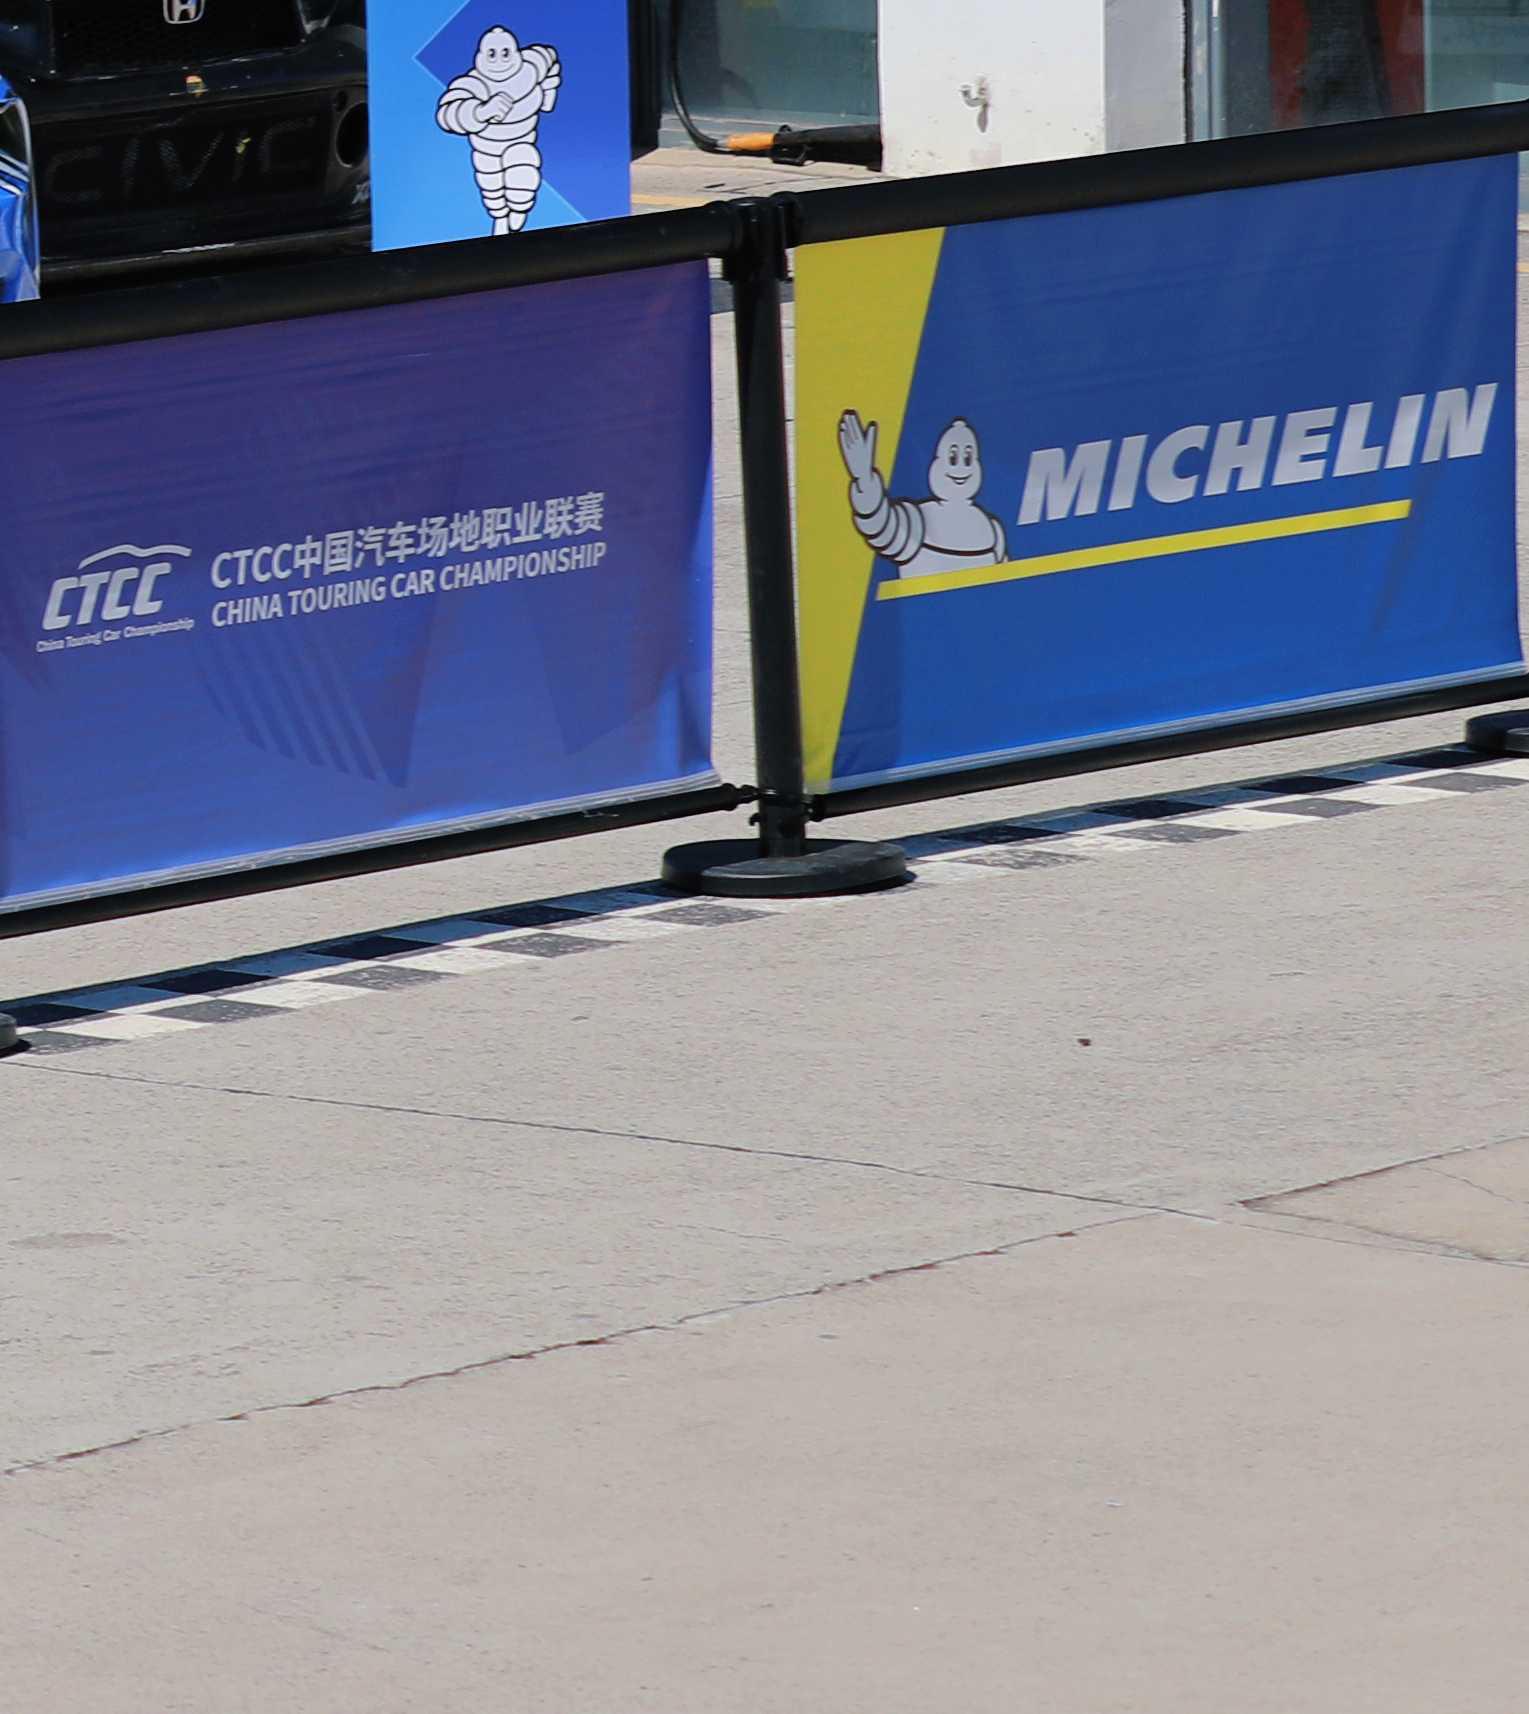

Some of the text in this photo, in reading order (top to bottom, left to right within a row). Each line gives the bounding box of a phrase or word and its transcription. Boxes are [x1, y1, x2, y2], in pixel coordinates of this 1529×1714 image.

[42, 115, 317, 204] CIVIC
[1016, 382, 1499, 526] MICHELIN
[209, 489, 604, 590] CTCC中国汽车场地职业联赛
[40, 561, 172, 631] CTCC
[210, 540, 608, 628] CHINA TOURING CAR CHAMPIONSHIP
[35, 617, 195, 654] China Touring Car Championship
